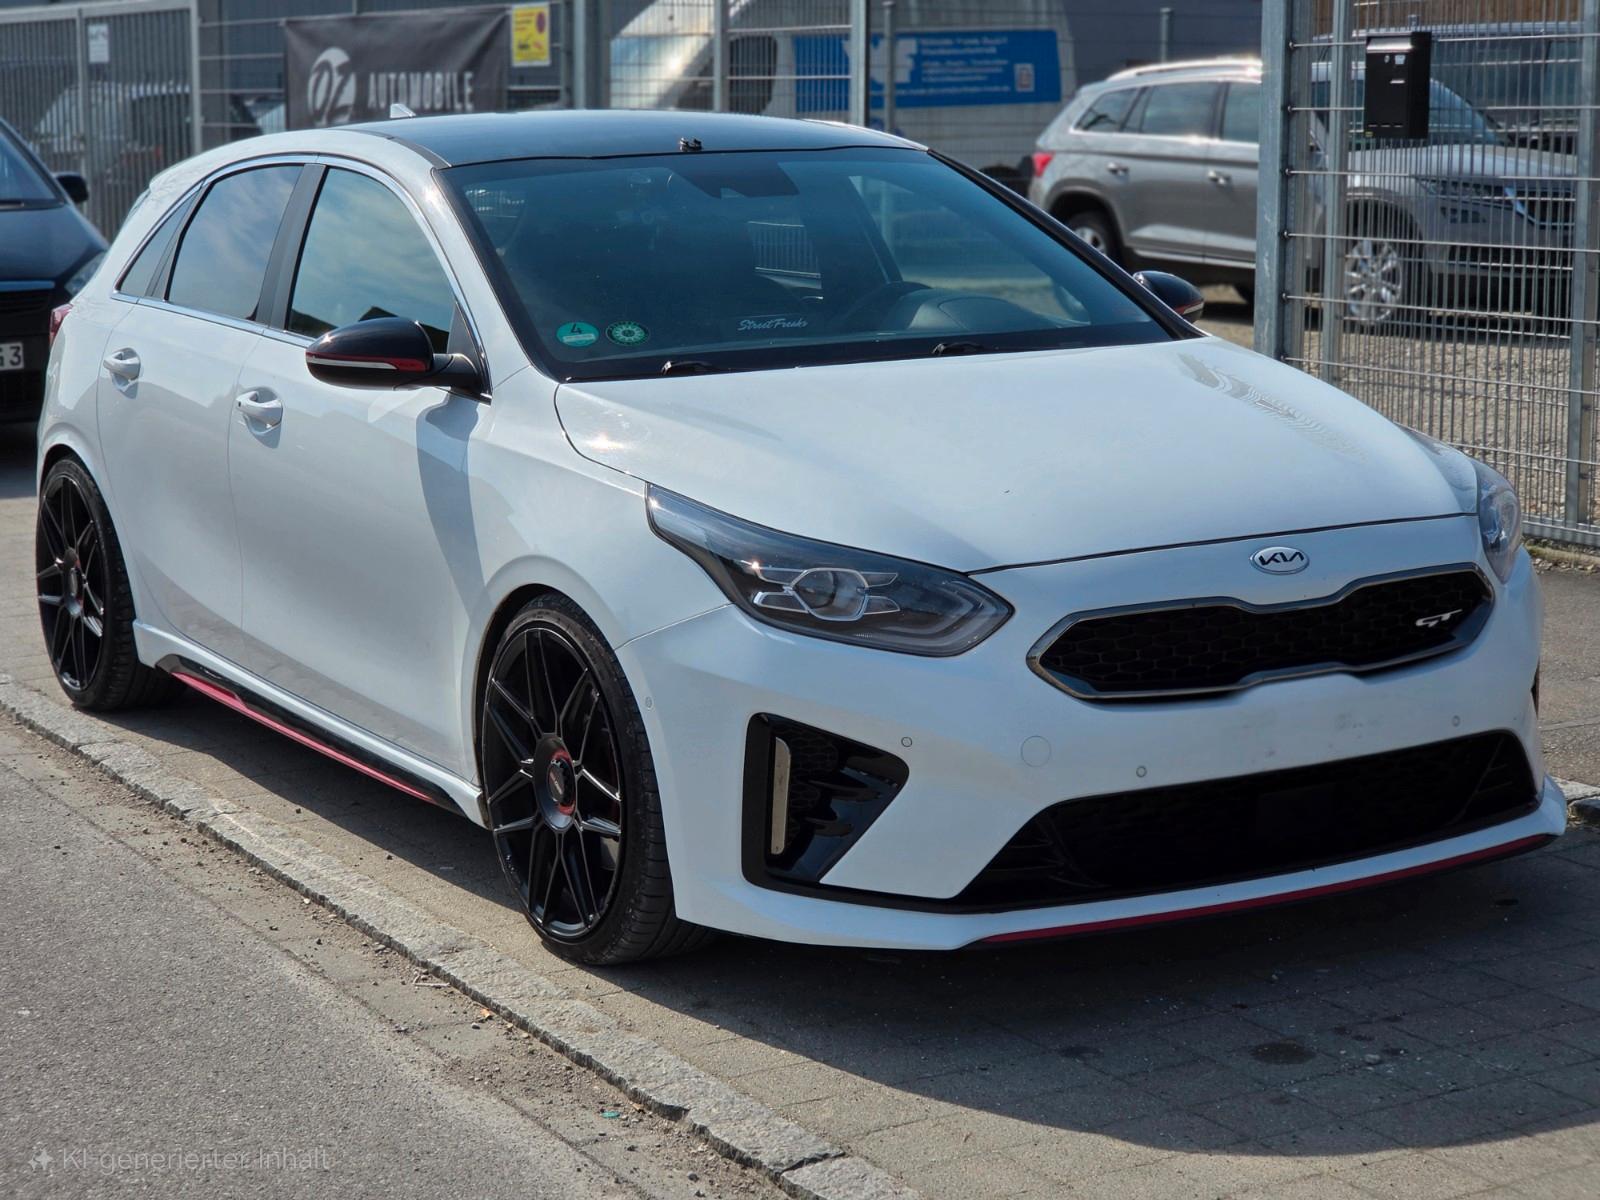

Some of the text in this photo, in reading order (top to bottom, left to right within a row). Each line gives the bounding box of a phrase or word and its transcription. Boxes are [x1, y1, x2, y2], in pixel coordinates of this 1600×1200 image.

[367, 71, 475, 111] AUTOMOBILE
[1258, 551, 1305, 566] KIA
[1415, 609, 1463, 628] GT
